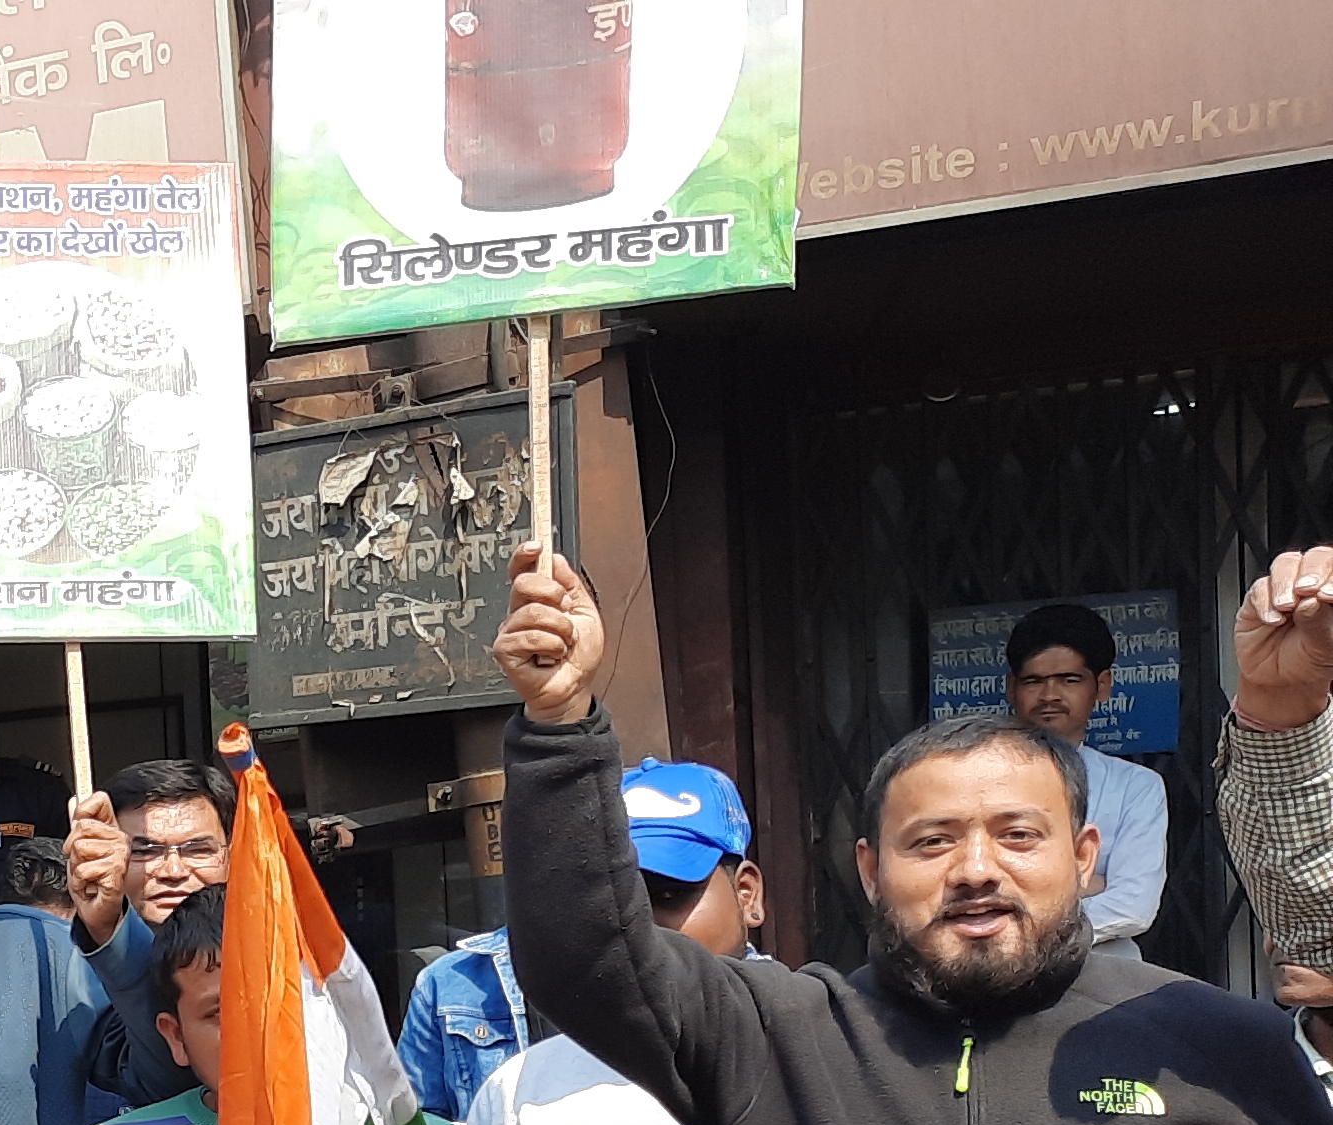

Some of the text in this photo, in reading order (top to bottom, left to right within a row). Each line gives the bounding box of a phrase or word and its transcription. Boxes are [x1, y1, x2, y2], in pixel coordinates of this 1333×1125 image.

[799, 143, 975, 200] ebsite
[70, 178, 151, 212] महंगा
[154, 179, 201, 211] तेल
[14, 230, 54, 253] का
[126, 221, 184, 254] खेल
[339, 209, 729, 286] सिलेण्डर महंगा
[61, 569, 177, 606] महंगा
[260, 555, 316, 598] जय
[1079, 1090, 1134, 1102] NORTH
[1101, 1078, 1133, 1093] THE
[1096, 1102, 1136, 1114] FACE
